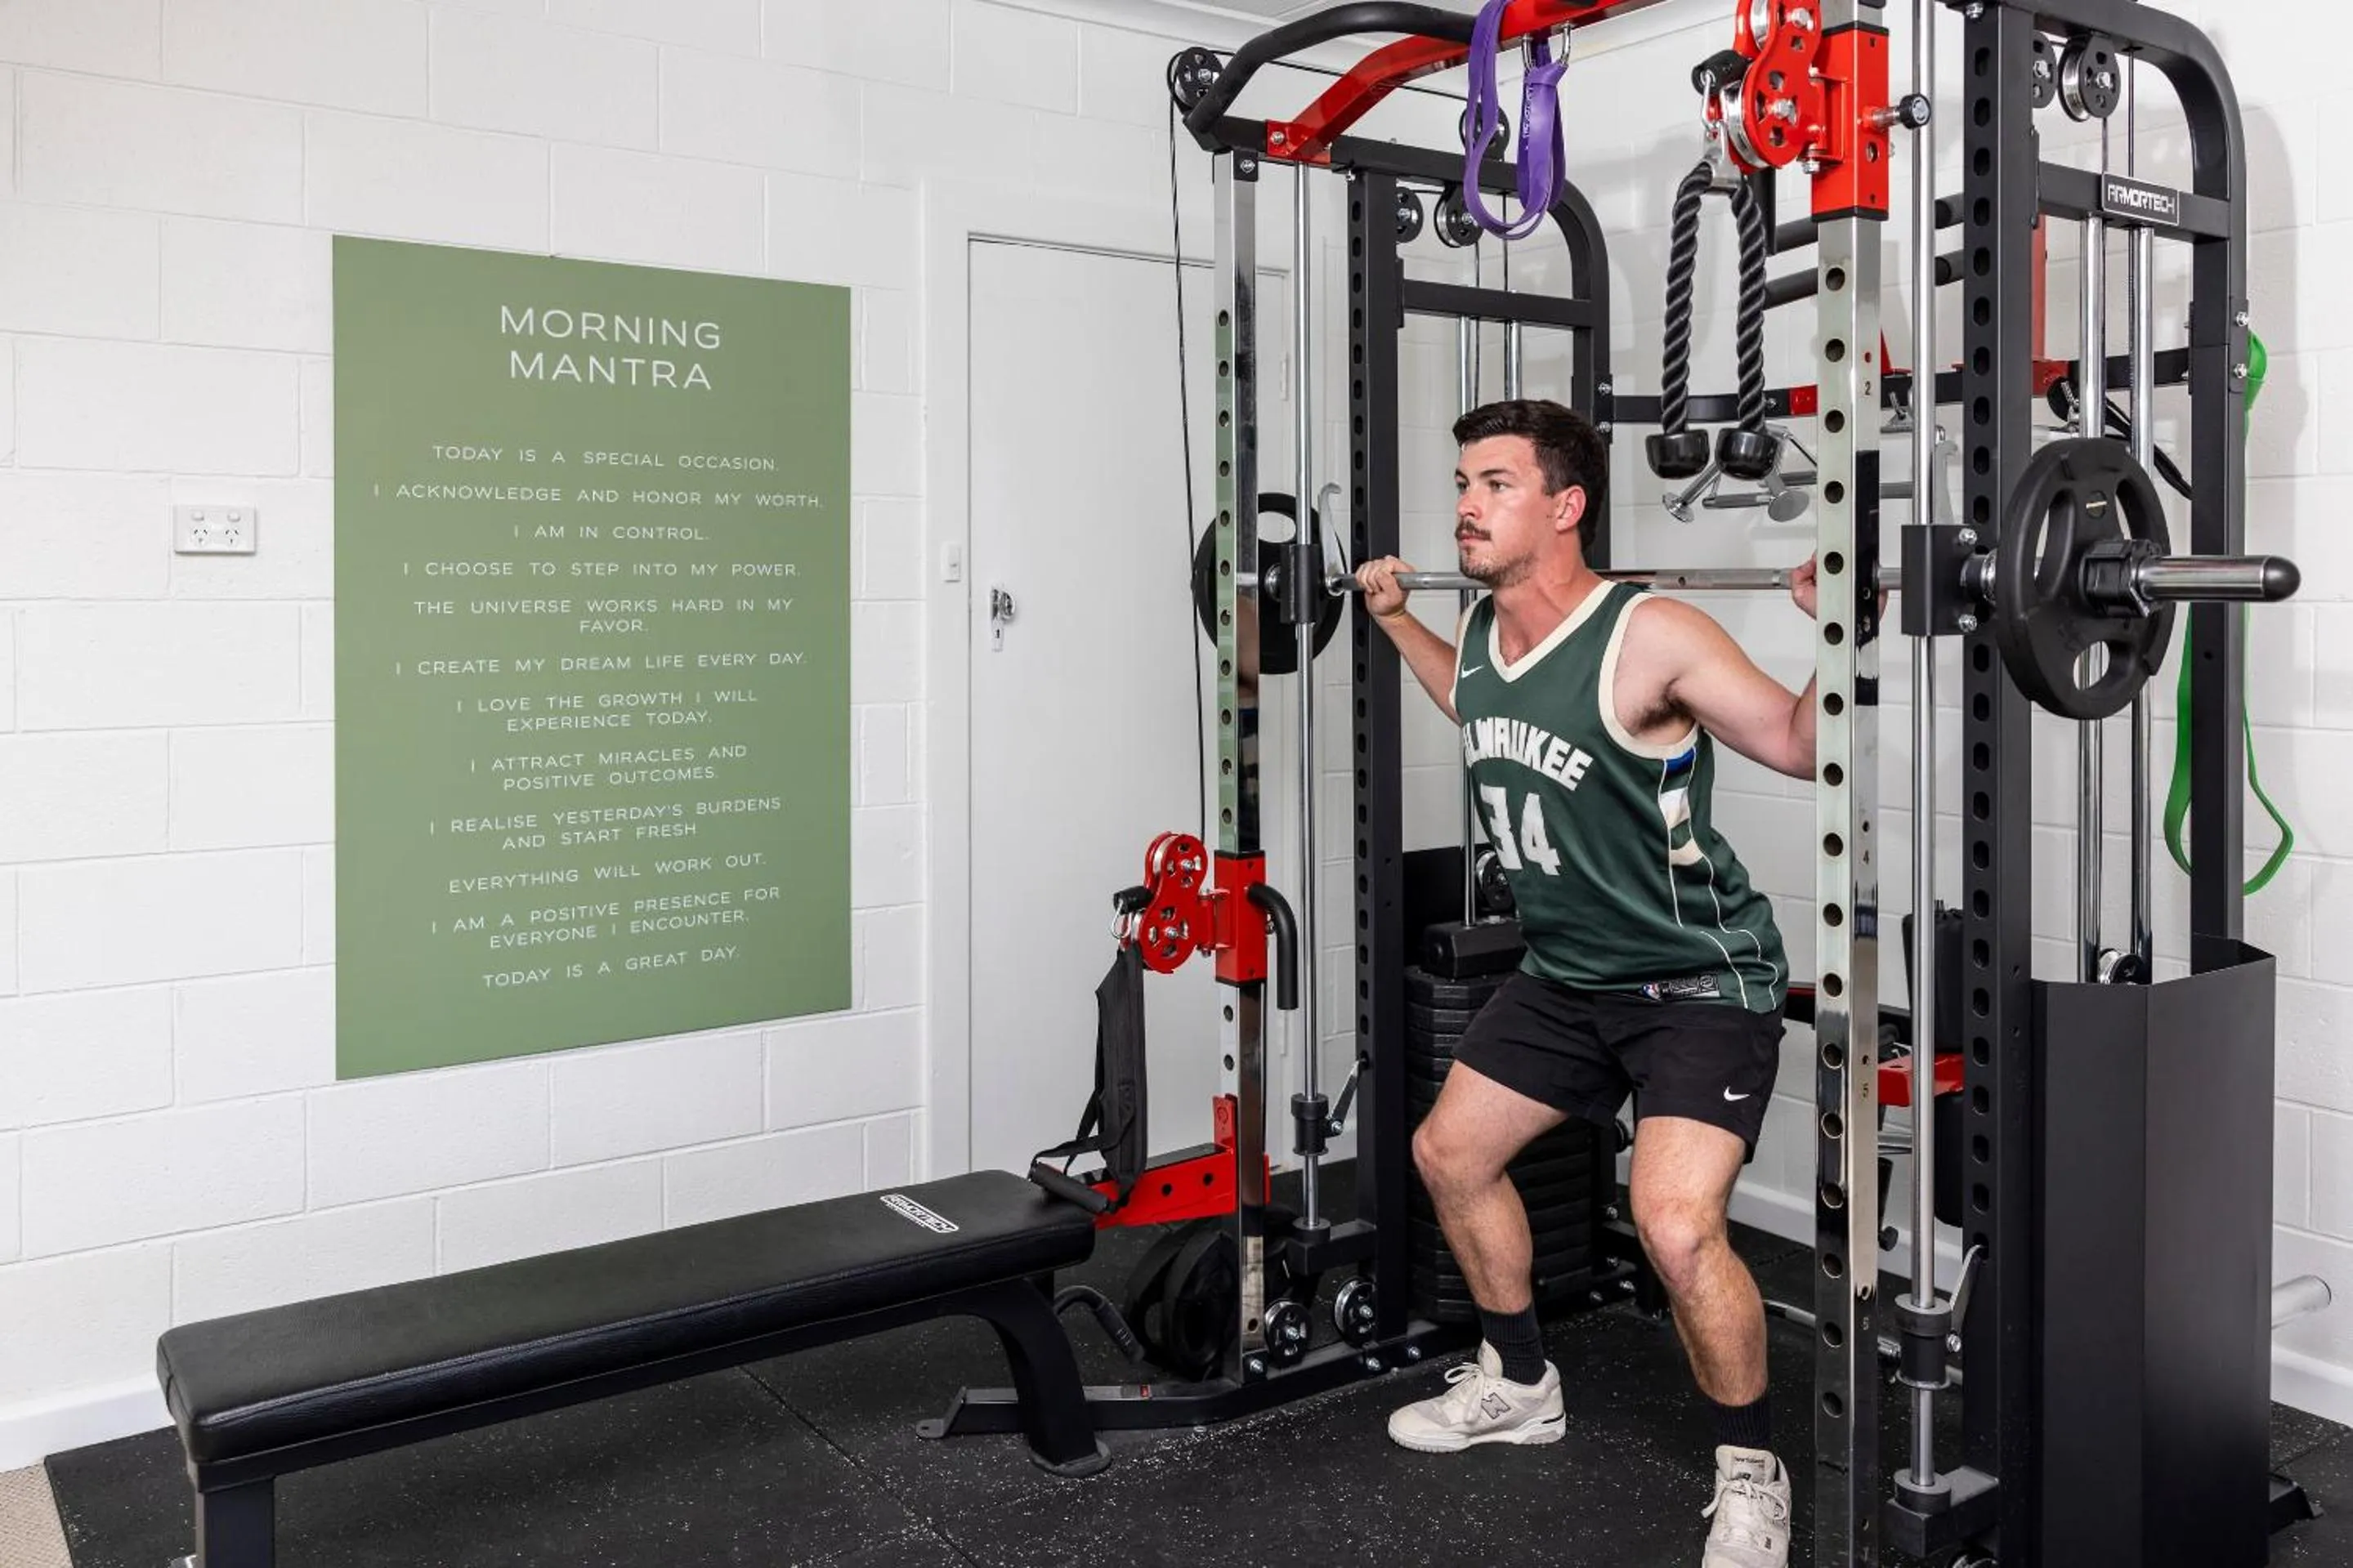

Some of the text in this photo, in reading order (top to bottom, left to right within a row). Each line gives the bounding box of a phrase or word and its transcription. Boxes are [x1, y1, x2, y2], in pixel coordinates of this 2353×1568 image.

[2107, 184, 2175, 214] ARMORTECH
[500, 305, 721, 351] MORNING
[510, 350, 712, 391] MANTRA
[432, 444, 780, 472] TODAY IS A SPECIAL OCCASION.
[374, 484, 823, 508] I ACKNOWLEDGE AND HONOR MY WORTH.
[514, 525, 709, 541] I AM IN CONTROL.
[404, 561, 801, 578] I CHOOSE TO STEP INTO MY POWER.
[413, 598, 794, 615] THE UNIVERSE WORKS HARD IN MY
[579, 619, 649, 634] FAVOR.
[396, 651, 808, 676] I CREATE MY DREAM LIFE EVERY DAY.
[457, 689, 758, 713] I LOVE THE GROWTH I WILL
[506, 709, 712, 732] EXPERIENCE TODAY.
[471, 744, 747, 774] I ATTRACT MIRACLES AND
[503, 766, 719, 791] POSITIVE OUTCOMES.
[430, 796, 781, 836] I REALISE YESTERDAY'S BURDENS
[1480, 783, 1561, 876] 34
[502, 822, 696, 851] AND START FRESH
[449, 852, 766, 894] EVERYTHING WILL WORK OUT.
[432, 886, 781, 935] I AM A POSITIVE PRESENCE FOR
[490, 909, 749, 949] EVERYONE I ENCOUNTER.
[482, 945, 740, 988] TODAY IS A GREAT DAY.
